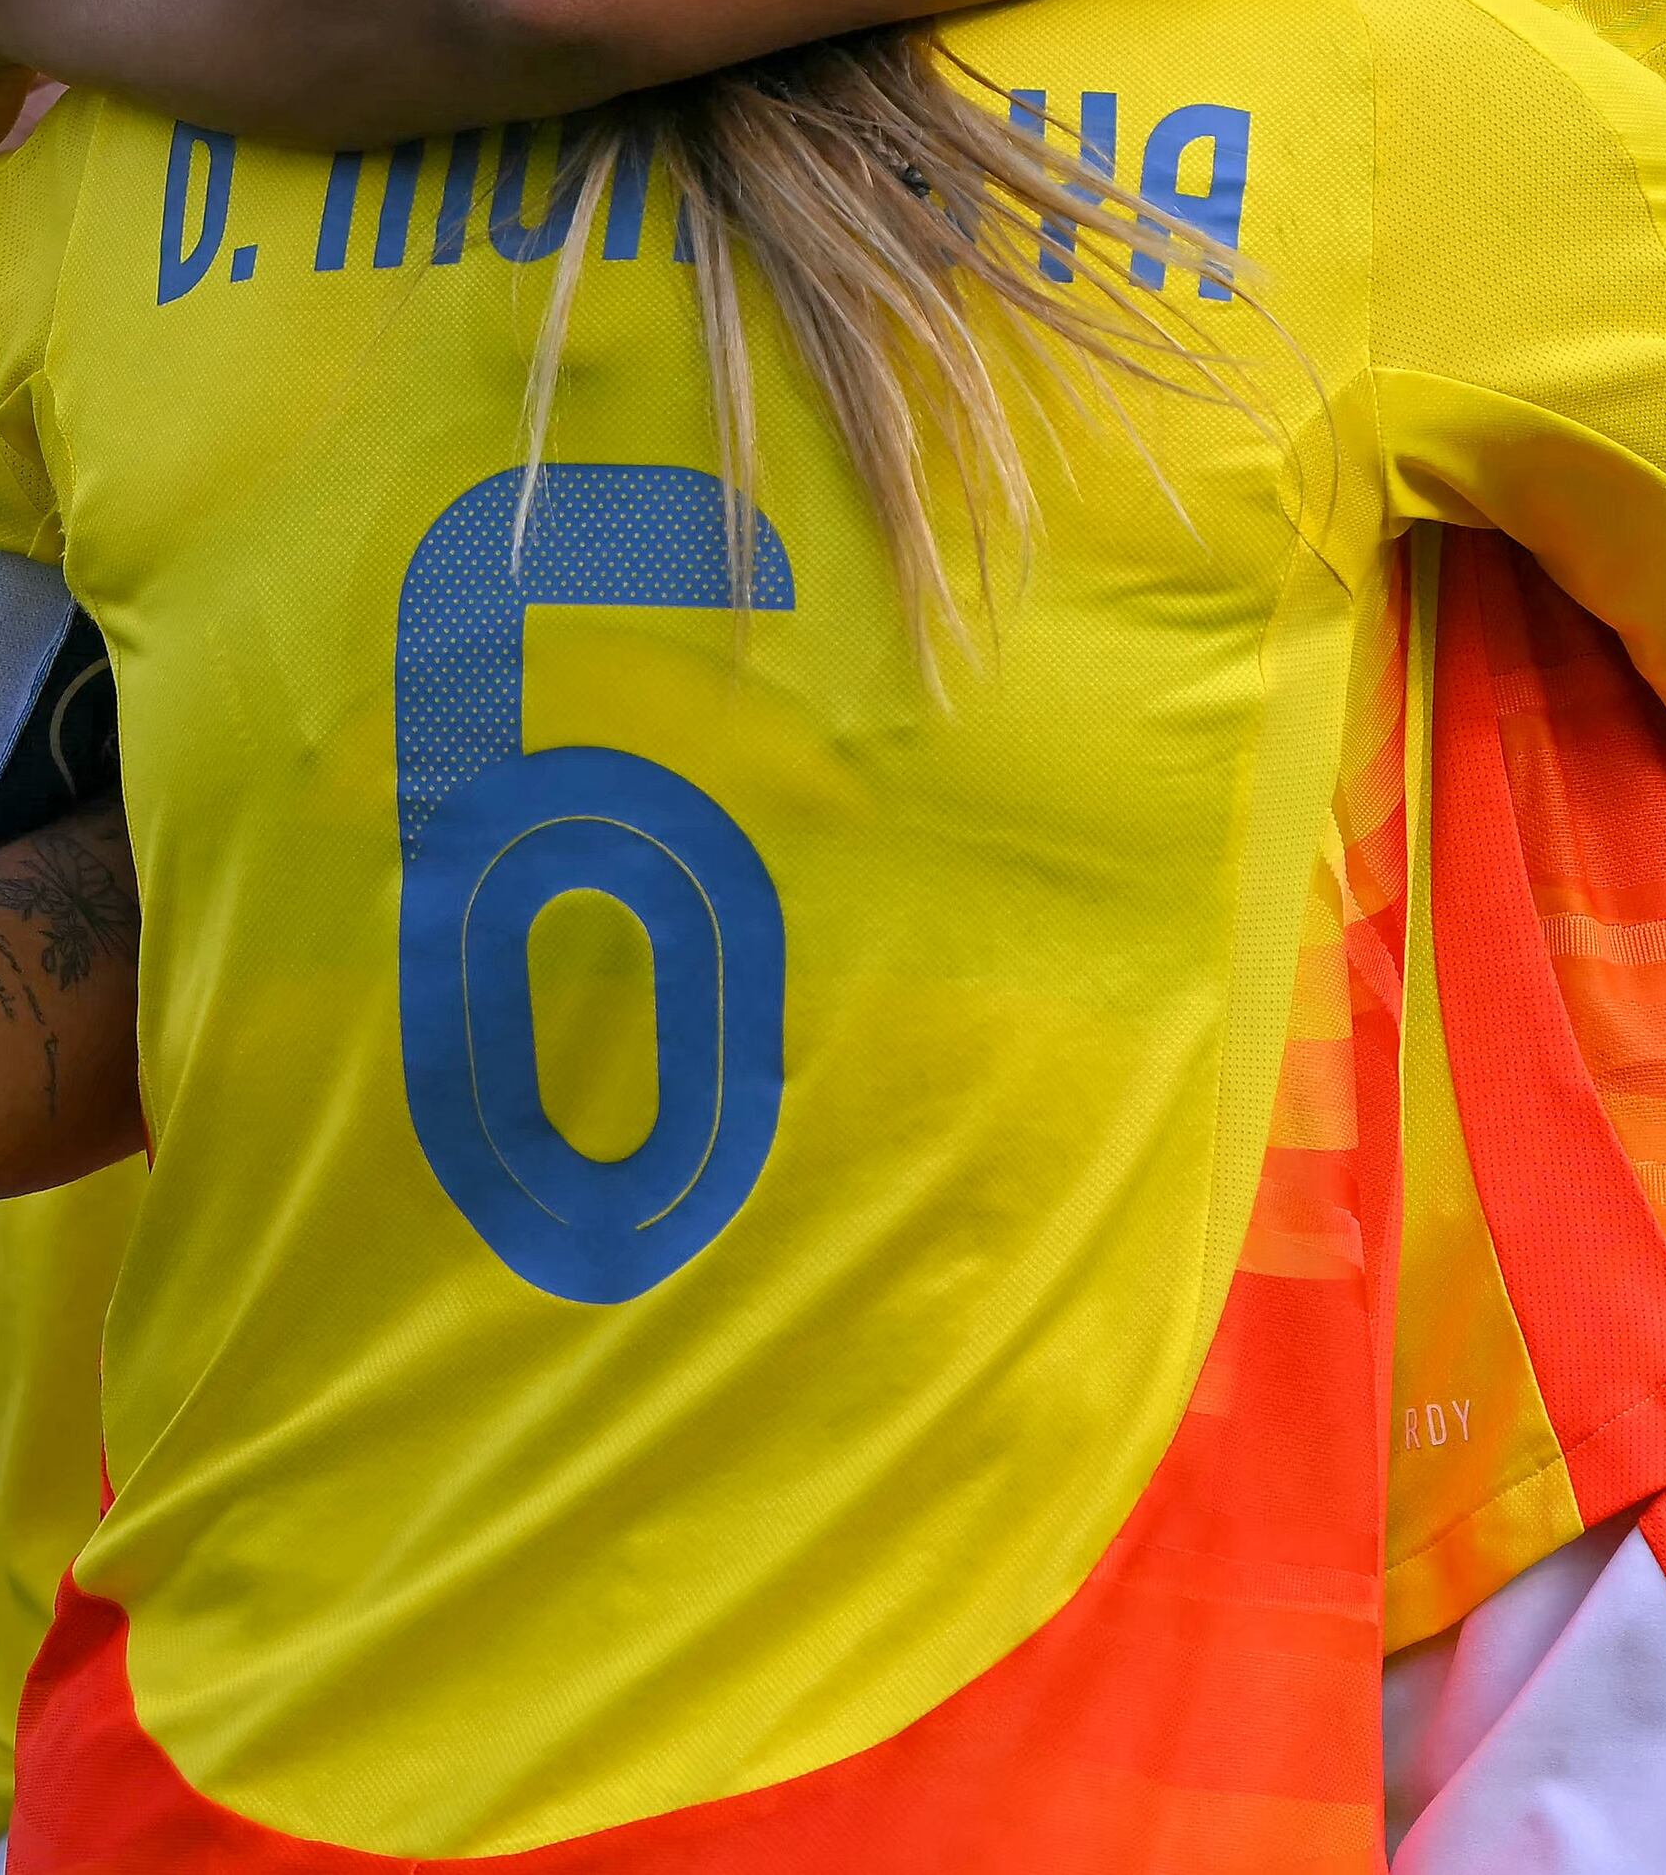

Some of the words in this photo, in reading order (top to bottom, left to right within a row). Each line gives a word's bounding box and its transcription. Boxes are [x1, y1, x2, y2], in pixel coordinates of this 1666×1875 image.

[158, 118, 259, 306] D.
[314, 89, 1253, 302] MOYA
[395, 462, 796, 1306] 6
